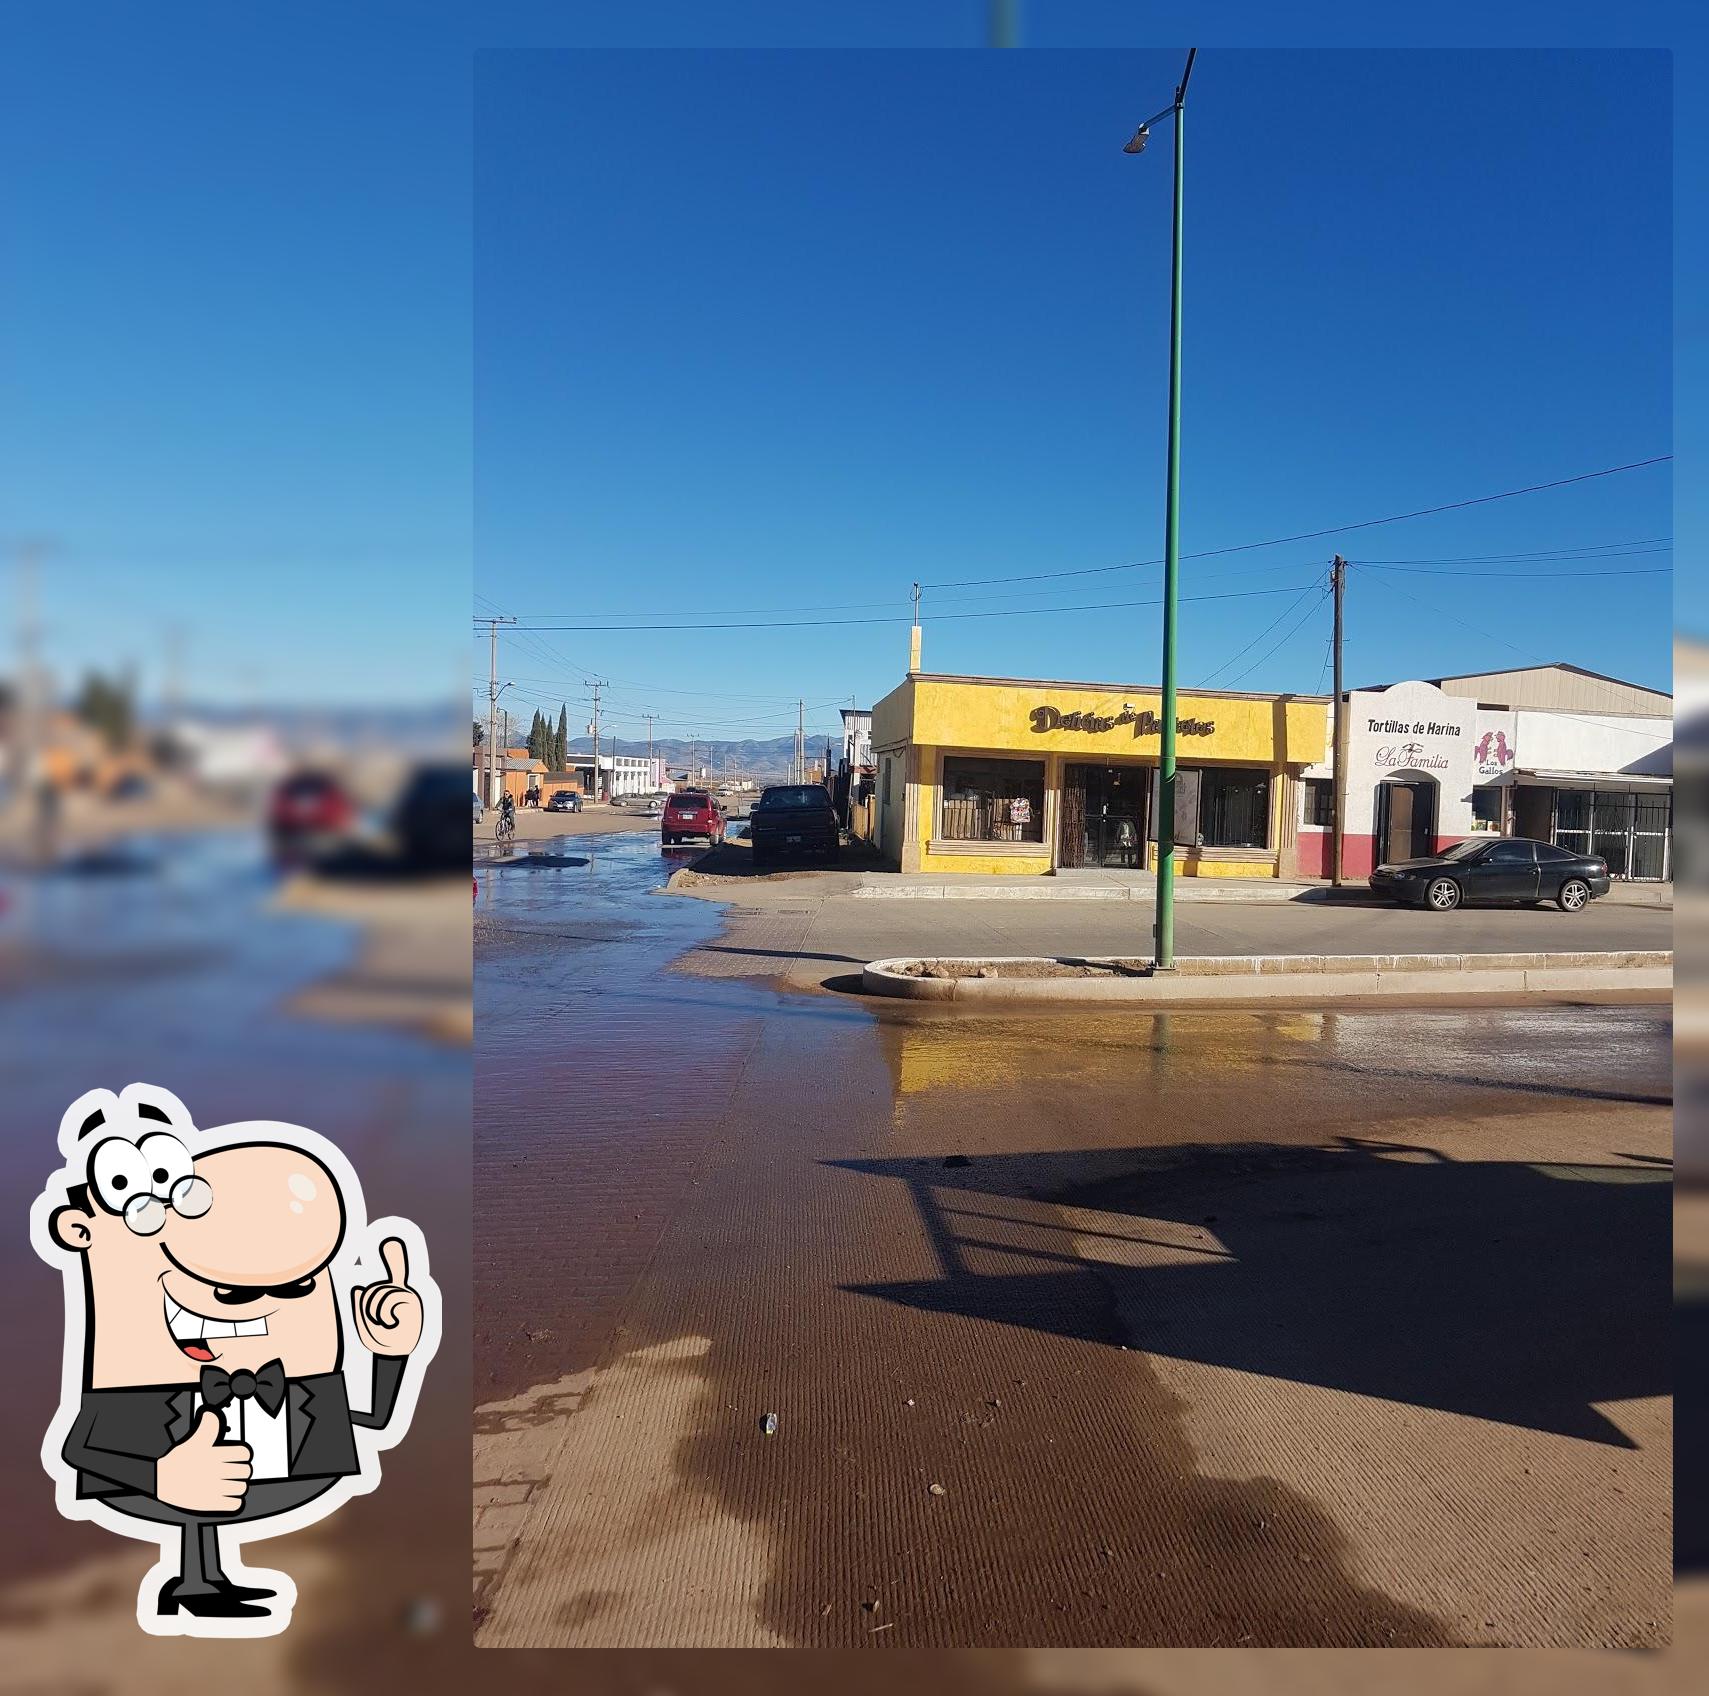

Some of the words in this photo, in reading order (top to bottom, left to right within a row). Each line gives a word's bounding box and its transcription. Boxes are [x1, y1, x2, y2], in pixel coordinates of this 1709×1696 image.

[1115, 711, 1135, 726] de
[1368, 719, 1410, 734] Tortillas
[1412, 721, 1425, 734] de
[1427, 721, 1461, 736] Harina
[1375, 746, 1397, 766] La
[1397, 743, 1449, 768] Familia
[1479, 766, 1504, 775] Gallos
